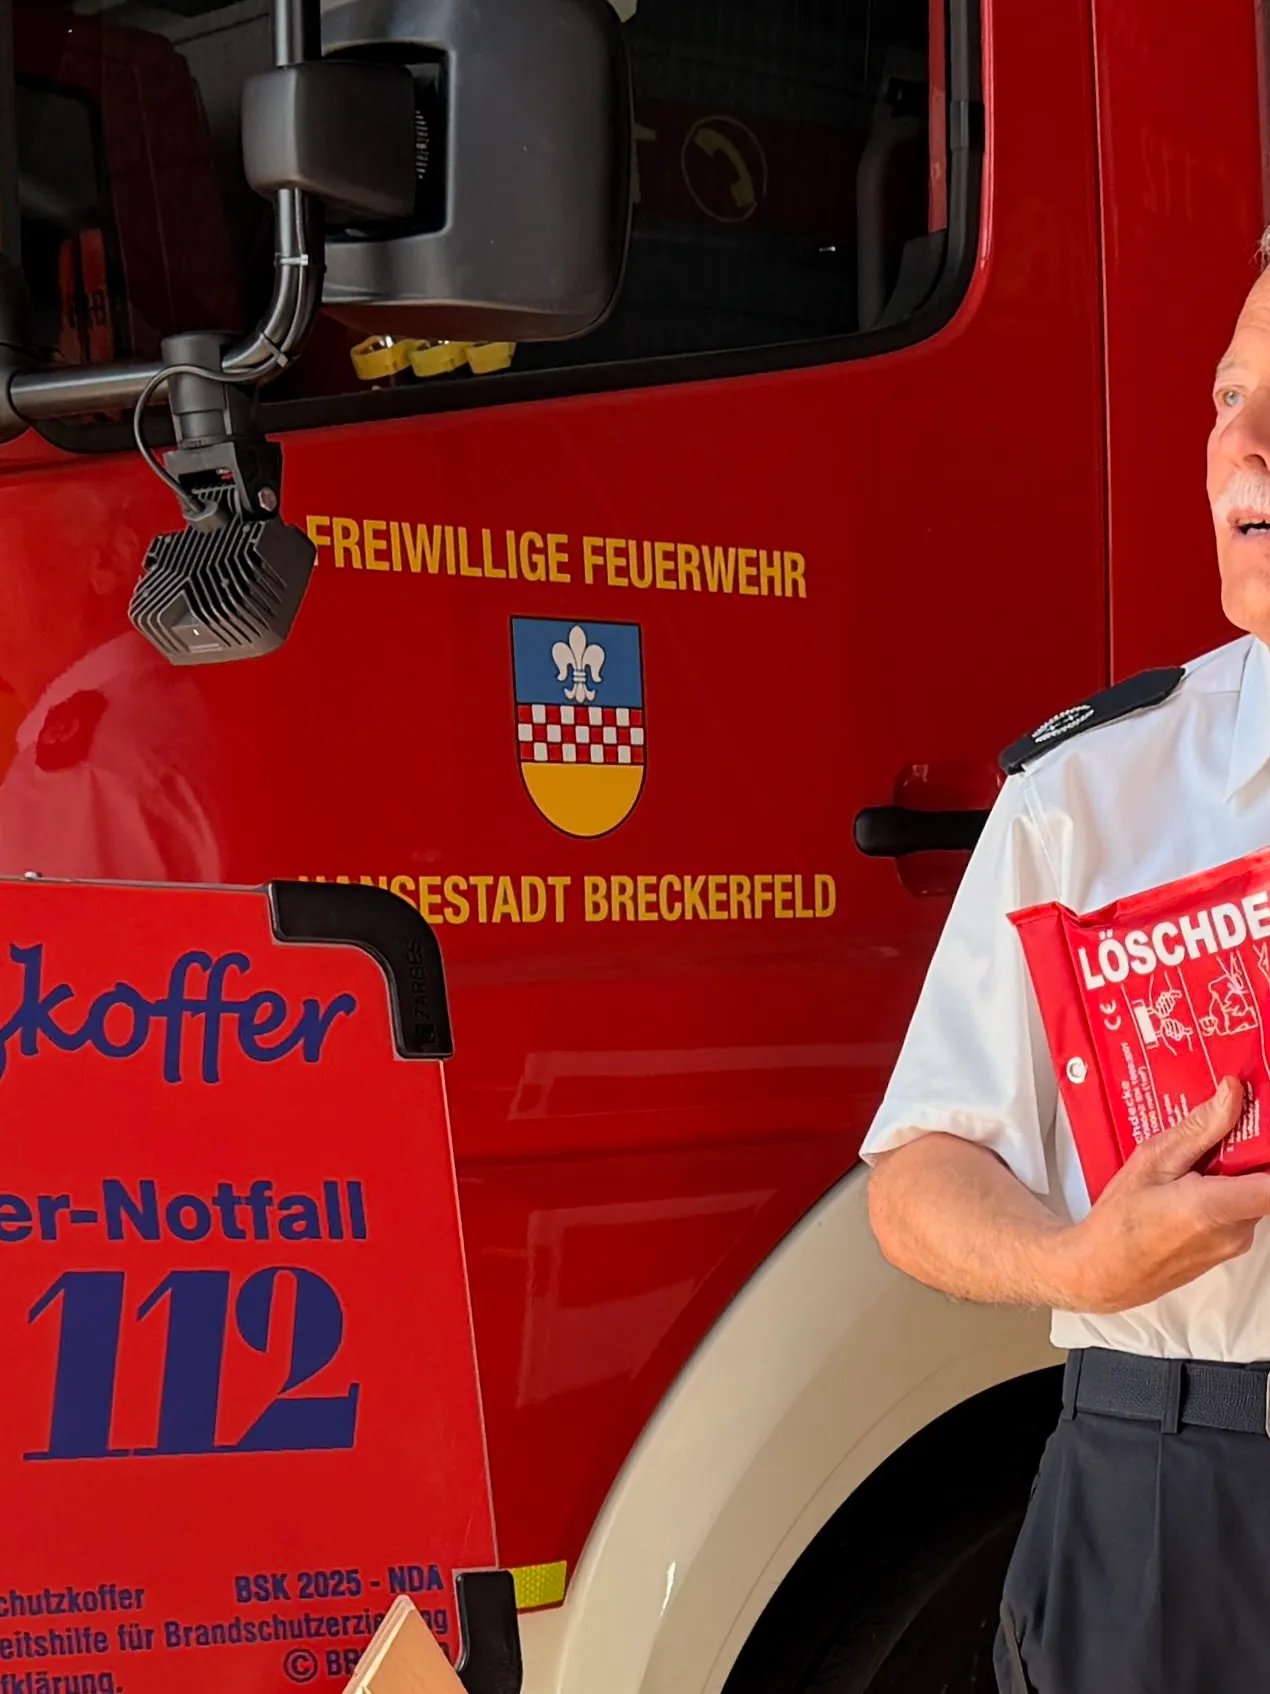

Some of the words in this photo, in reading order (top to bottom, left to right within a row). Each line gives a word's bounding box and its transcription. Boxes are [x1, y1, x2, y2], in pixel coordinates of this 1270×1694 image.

[306, 515, 571, 583] FREIWILLIGE
[583, 536, 807, 598] FEUERWEHR
[298, 875, 571, 925] SESTADT
[584, 874, 836, 922] BRECKERFELD
[0, 943, 356, 1083] koffer
[1121, 1080, 1144, 1144] chdecke
[23, 1266, 360, 1461] 112
[235, 1573, 292, 1604] BSK
[298, 1569, 362, 1600] 2025
[388, 1564, 444, 1594] NDA
[118, 1623, 155, 1651] für
